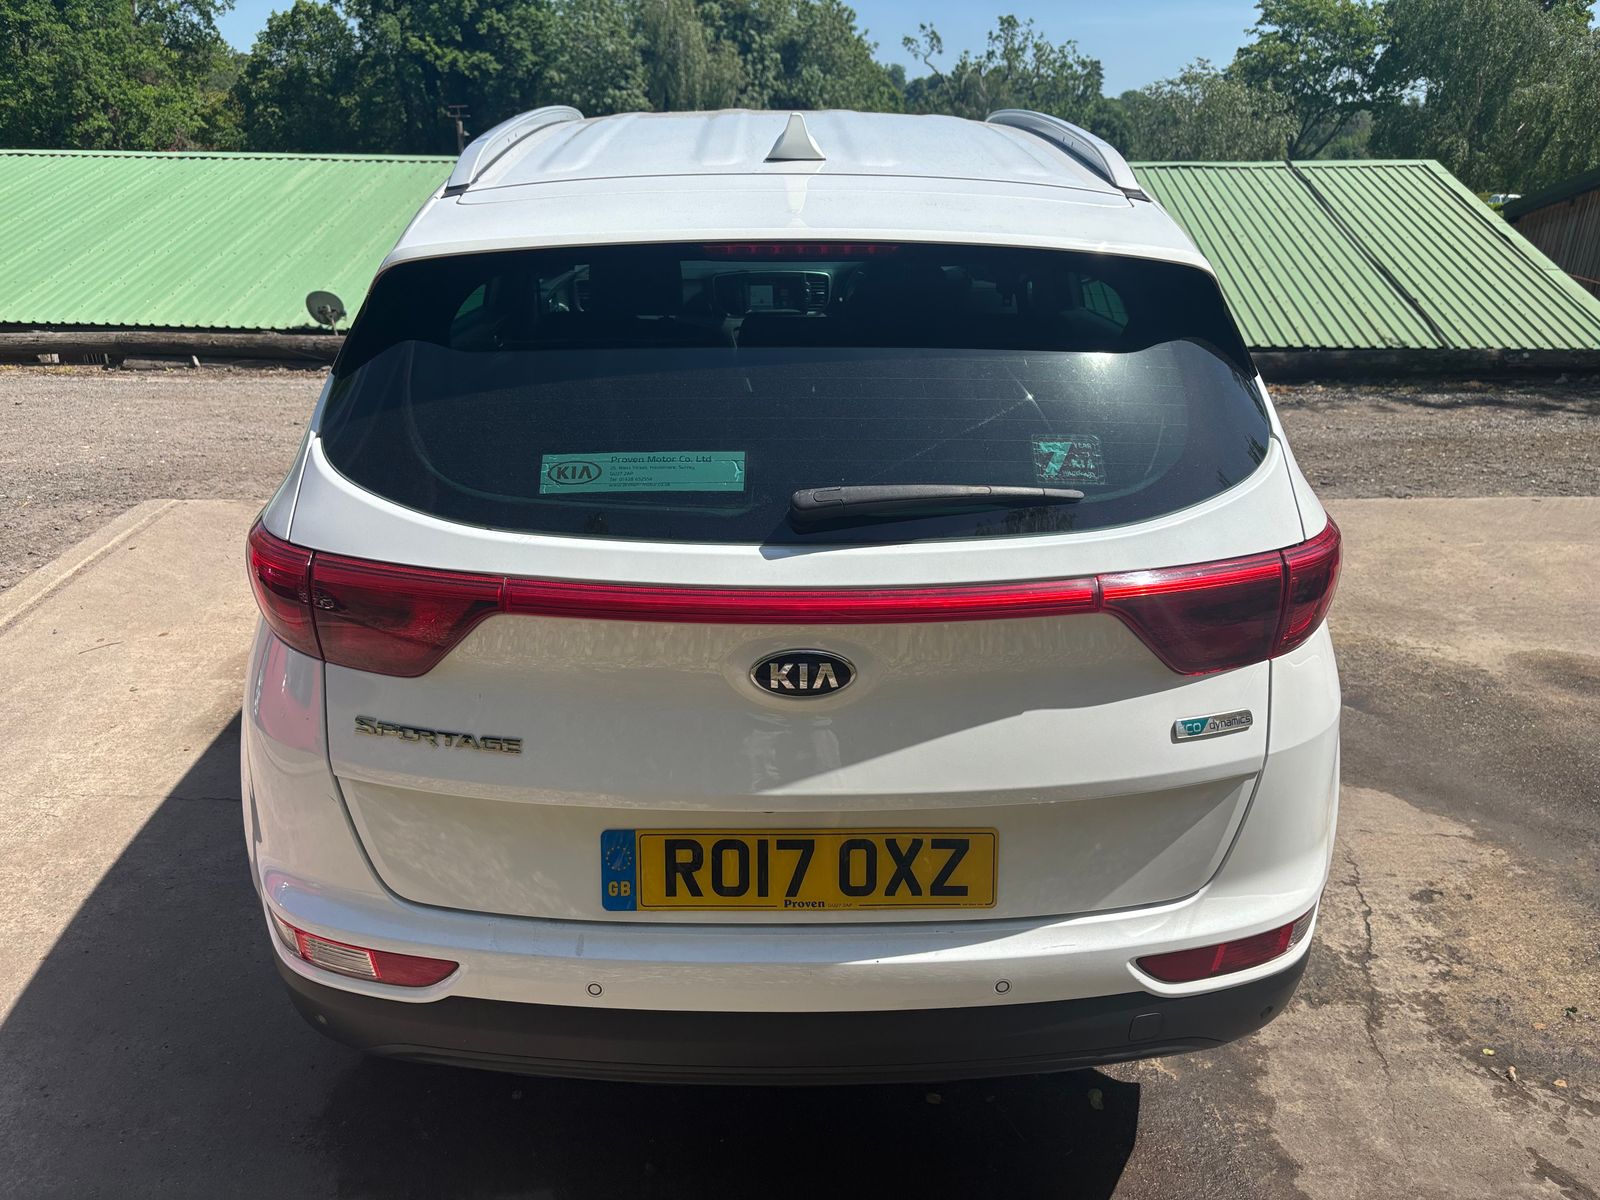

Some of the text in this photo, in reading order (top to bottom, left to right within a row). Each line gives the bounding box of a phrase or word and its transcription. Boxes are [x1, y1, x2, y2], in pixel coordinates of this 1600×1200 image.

[610, 455, 712, 464] Proven Motor Co. Ltd
[1040, 442, 1073, 476] 7
[556, 465, 593, 480] KIA
[768, 662, 839, 690] KIA
[1209, 715, 1251, 731] dynamics
[354, 713, 523, 754] SPORTAGE
[664, 837, 971, 898] RO17 OXZ
[607, 879, 631, 897] GB
[783, 899, 825, 908] Proven
